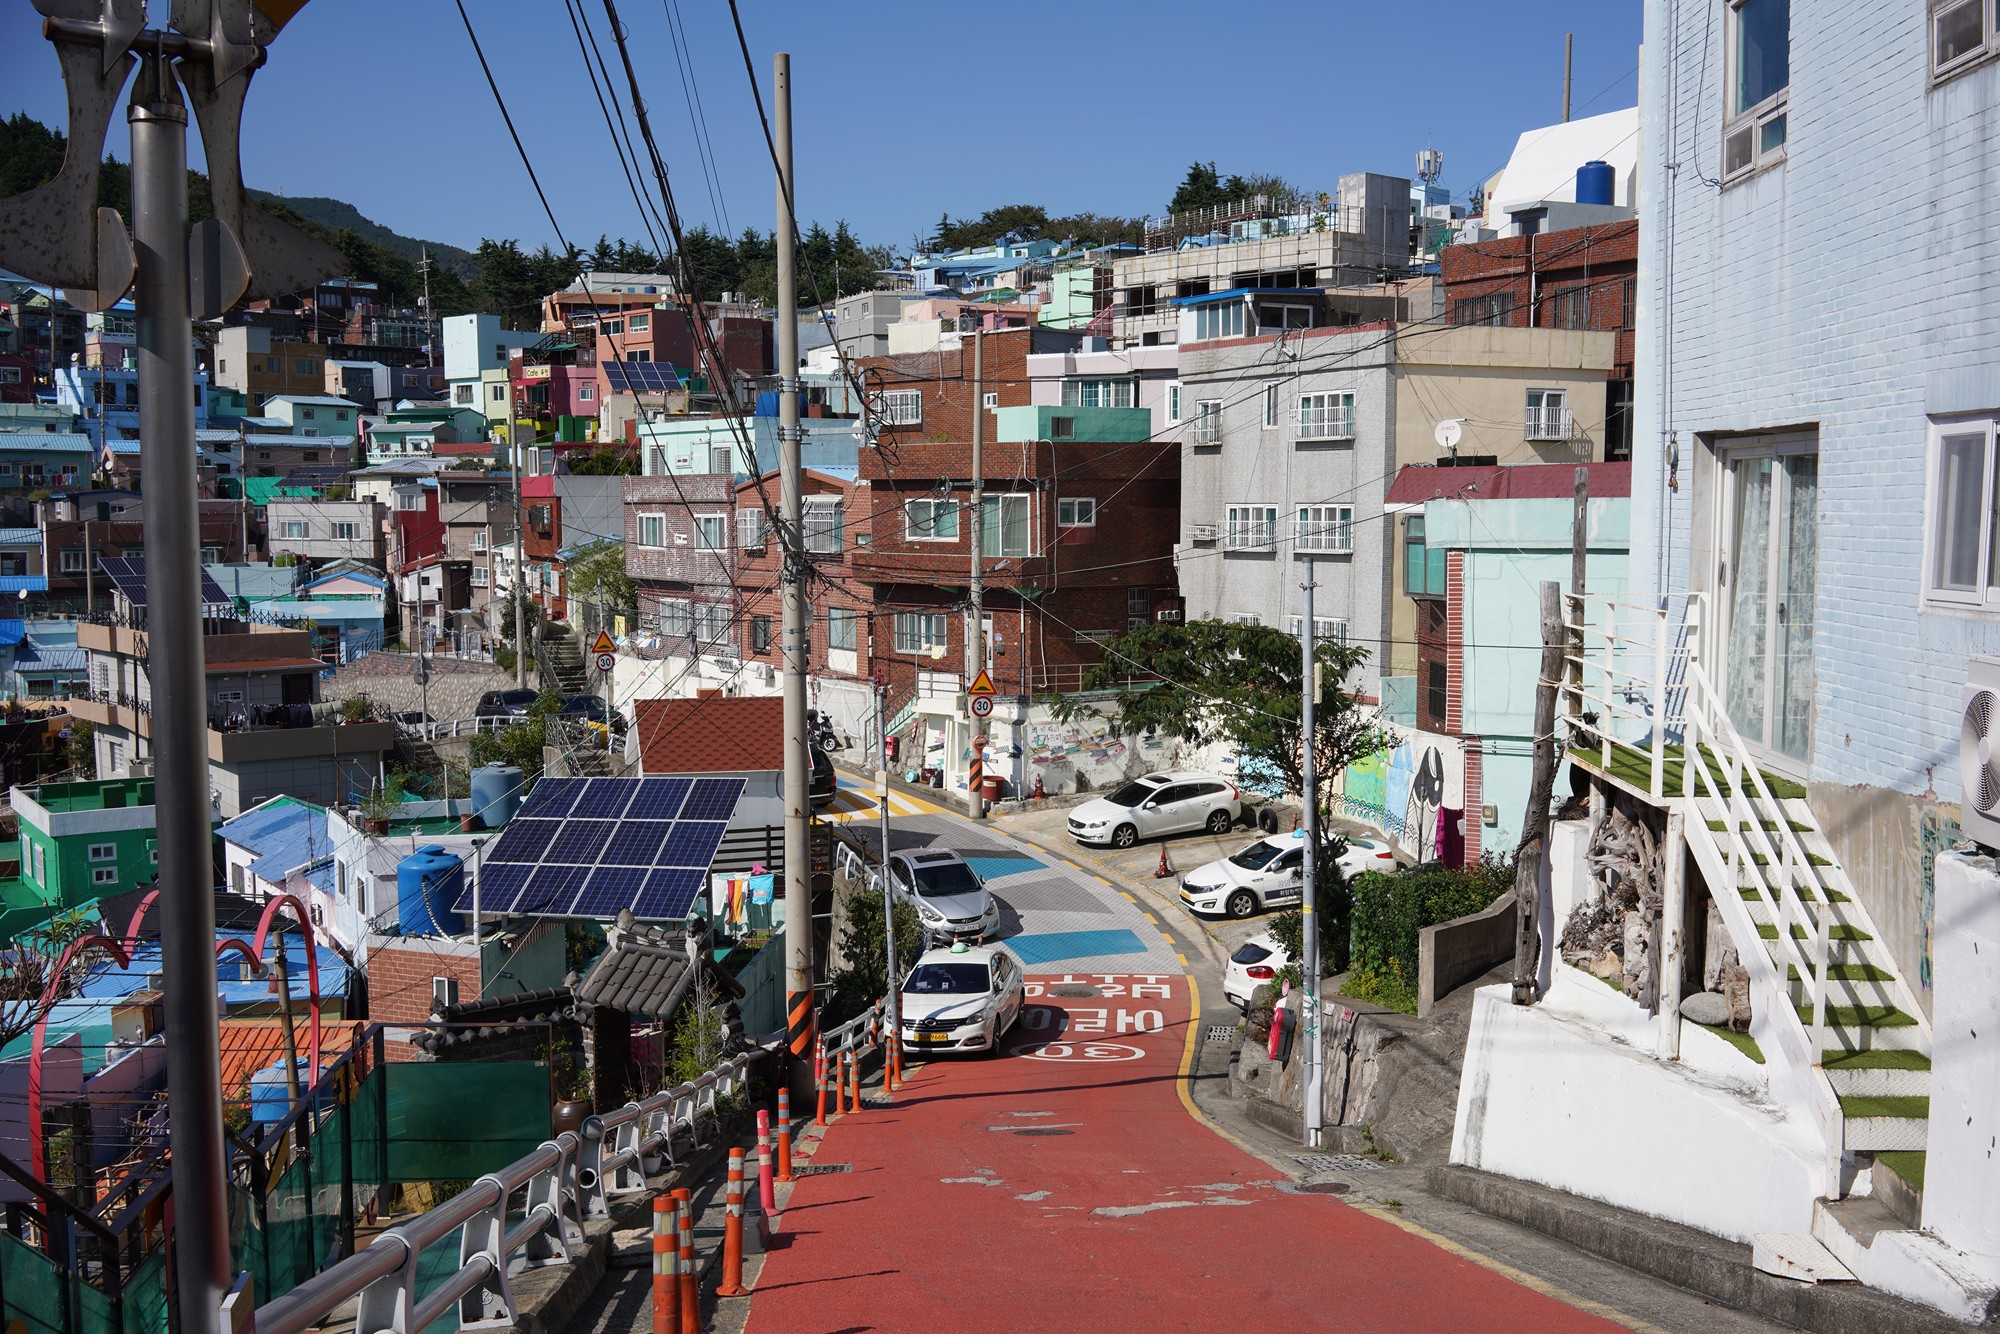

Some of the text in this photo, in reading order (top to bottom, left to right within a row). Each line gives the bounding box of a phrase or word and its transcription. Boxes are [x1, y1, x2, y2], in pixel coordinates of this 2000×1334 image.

[527, 369, 538, 377] Cafe
[600, 658, 611, 667] 30
[976, 701, 989, 711] 30
[1034, 1045, 1121, 1058] 30
